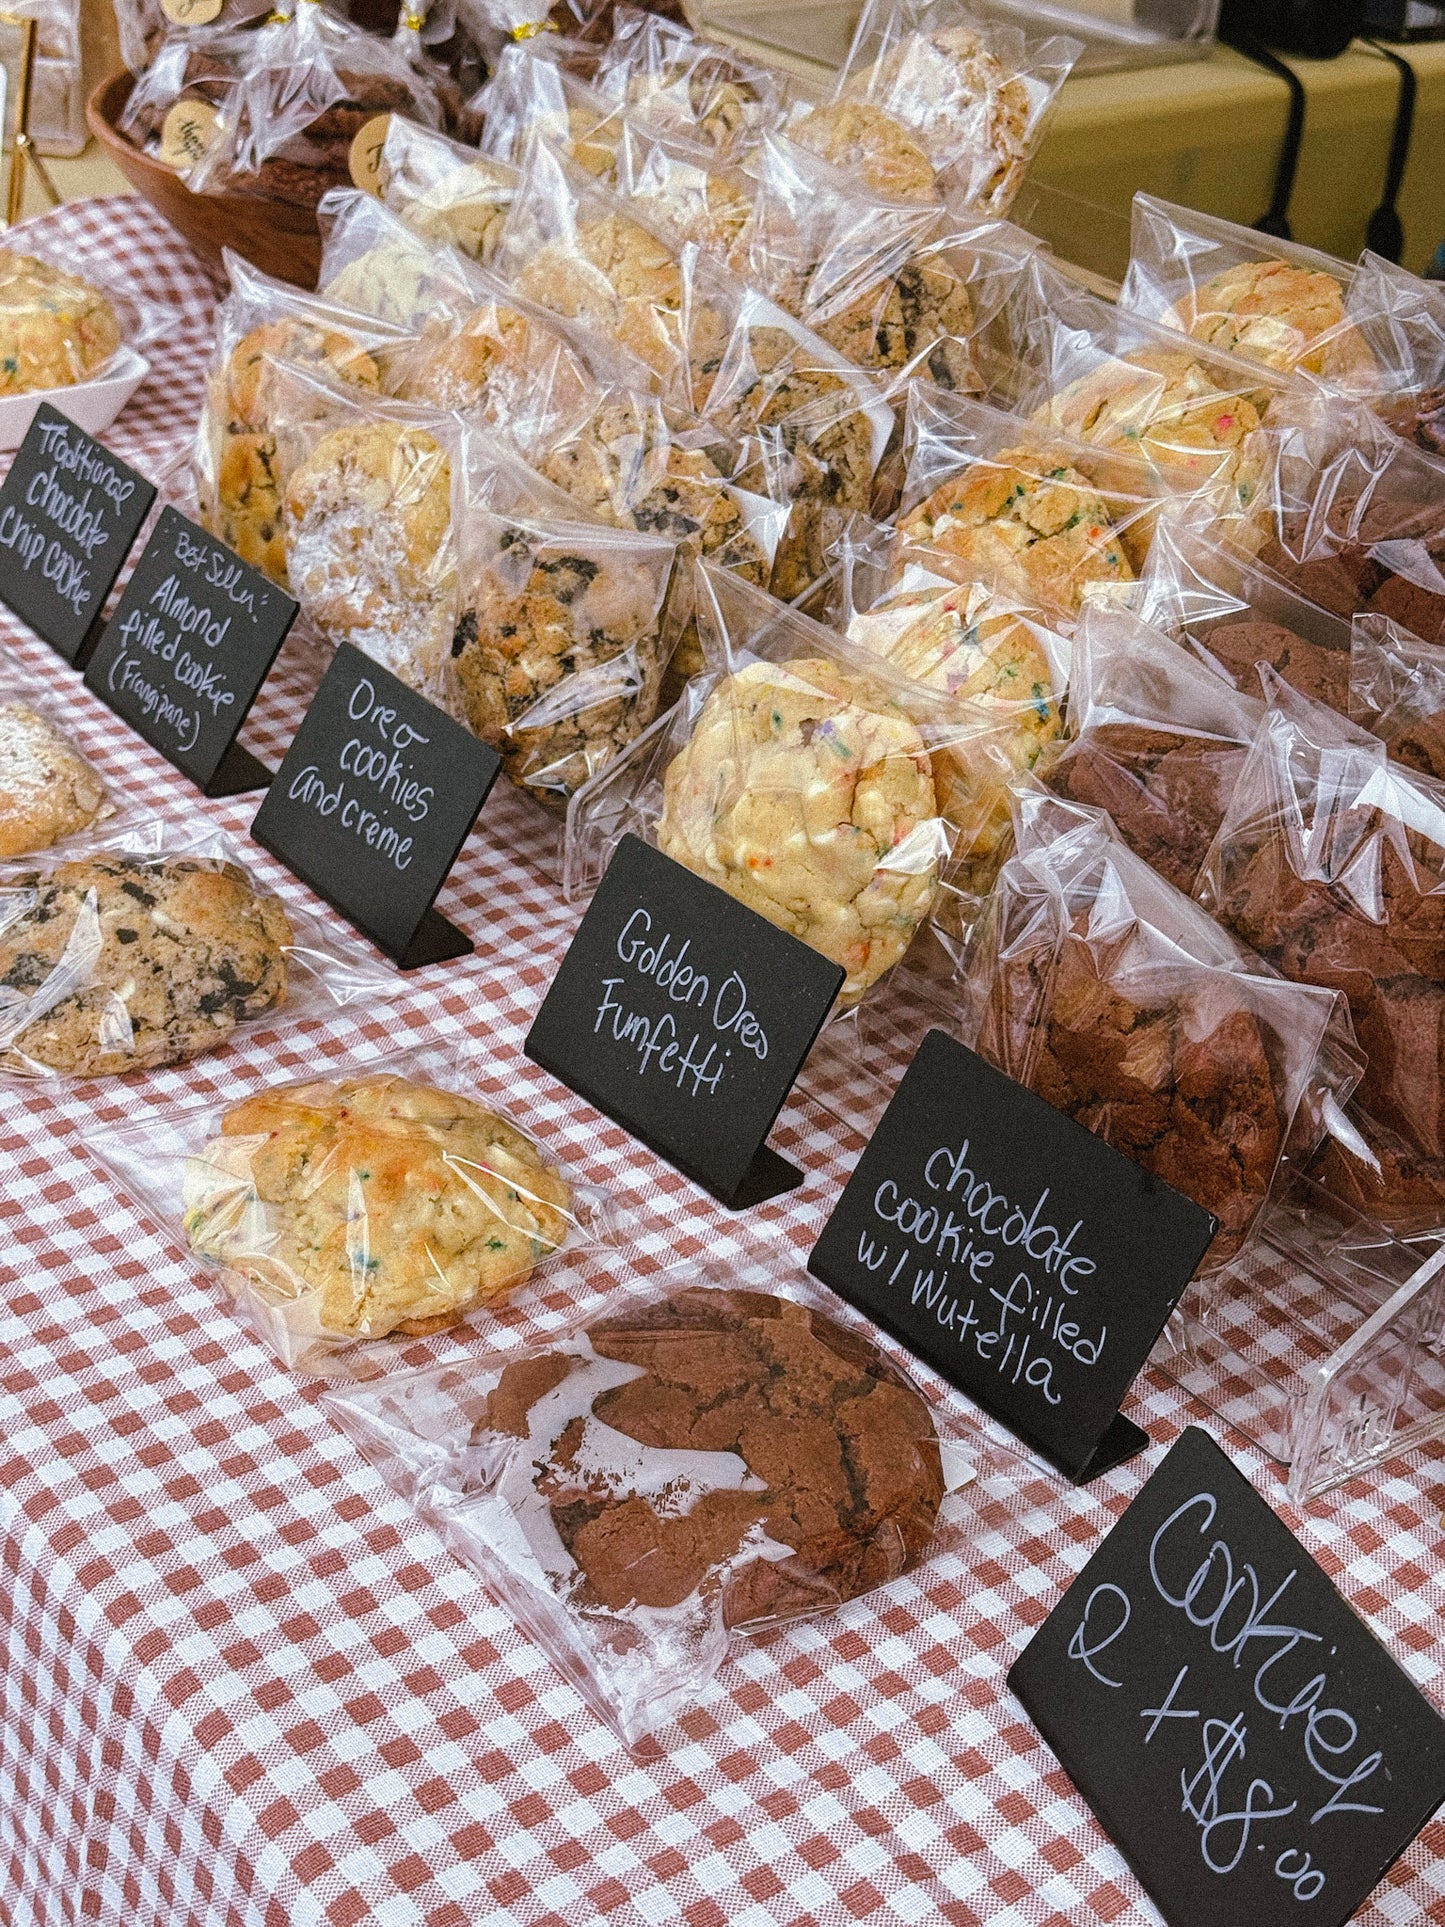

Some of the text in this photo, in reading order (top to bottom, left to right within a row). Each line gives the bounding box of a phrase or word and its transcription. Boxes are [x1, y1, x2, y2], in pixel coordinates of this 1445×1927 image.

[174, 531, 208, 573] Best
[119, 608, 182, 661] filled
[149, 573, 231, 647] Almond
[348, 678, 430, 748] Oreo
[340, 738, 434, 821] cookies
[617, 908, 769, 1061] Golden Oreo
[593, 978, 732, 1097] Funfetti
[874, 1179, 1106, 1365] cookie filled
[911, 1269, 1062, 1405] Nutella
[1181, 1712, 1326, 1901] $8.00
